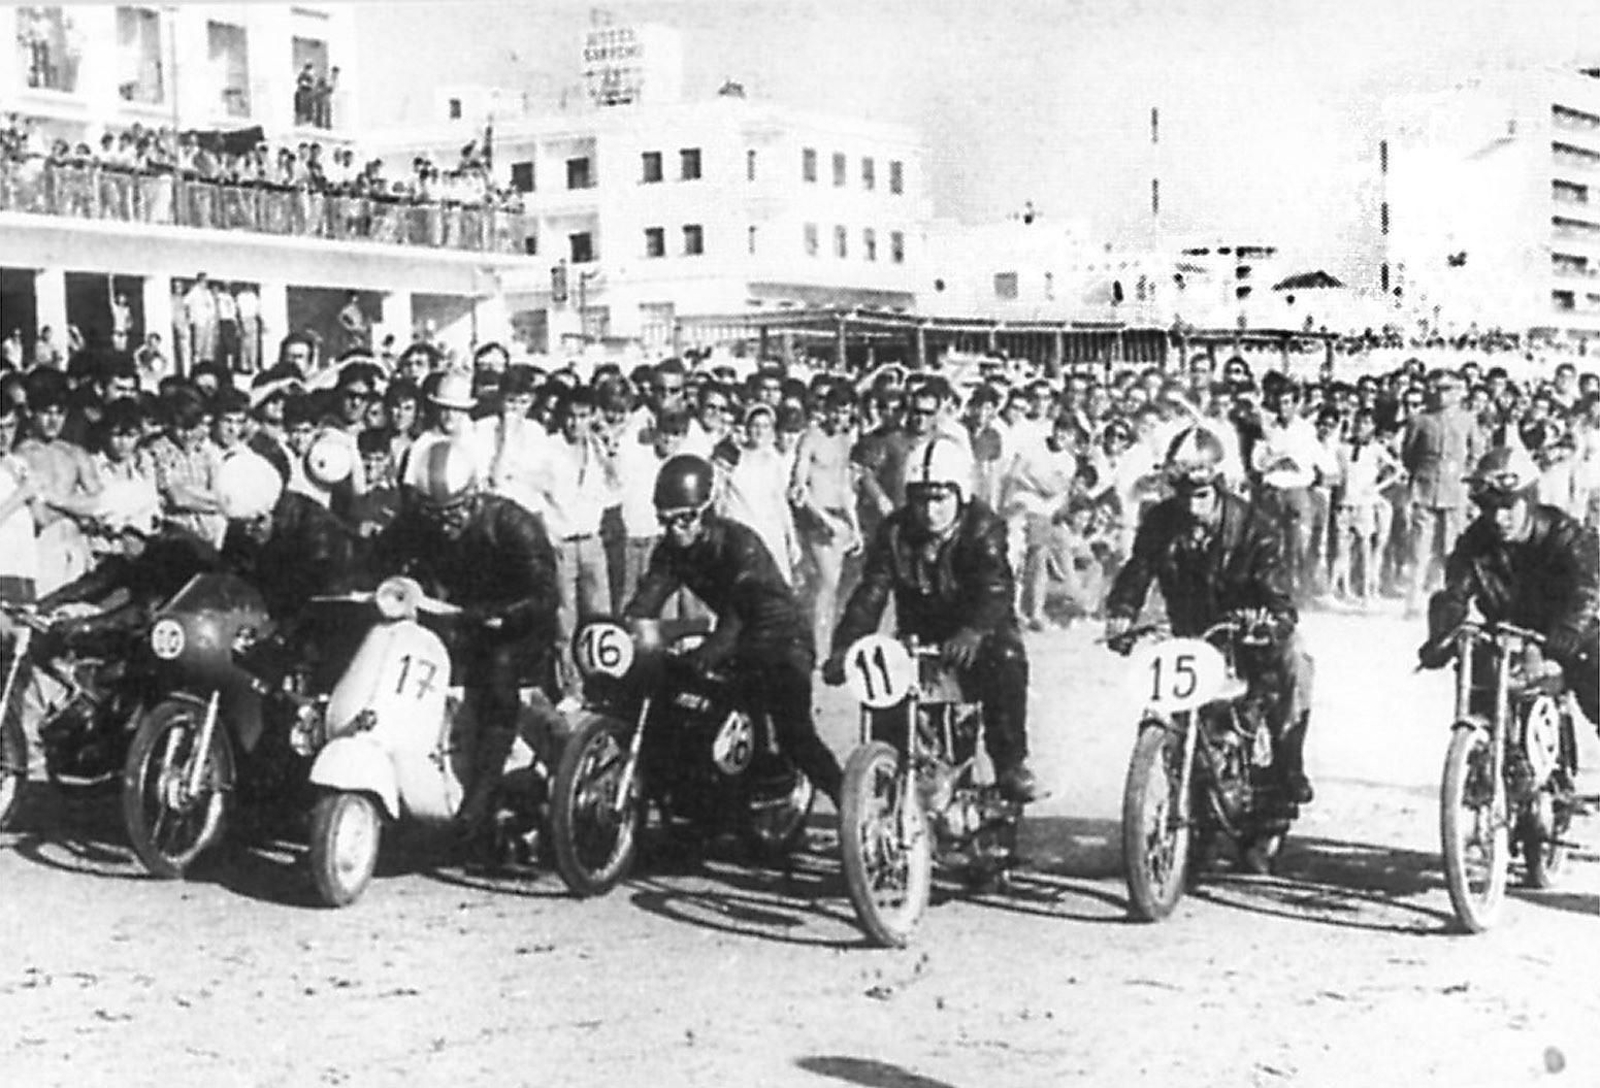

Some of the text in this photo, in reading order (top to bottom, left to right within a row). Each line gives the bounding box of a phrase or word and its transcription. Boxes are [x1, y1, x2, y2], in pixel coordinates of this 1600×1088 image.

[580, 629, 621, 667] 16
[396, 654, 436, 700] 17
[855, 645, 892, 700] 11
[1150, 655, 1197, 701] 15
